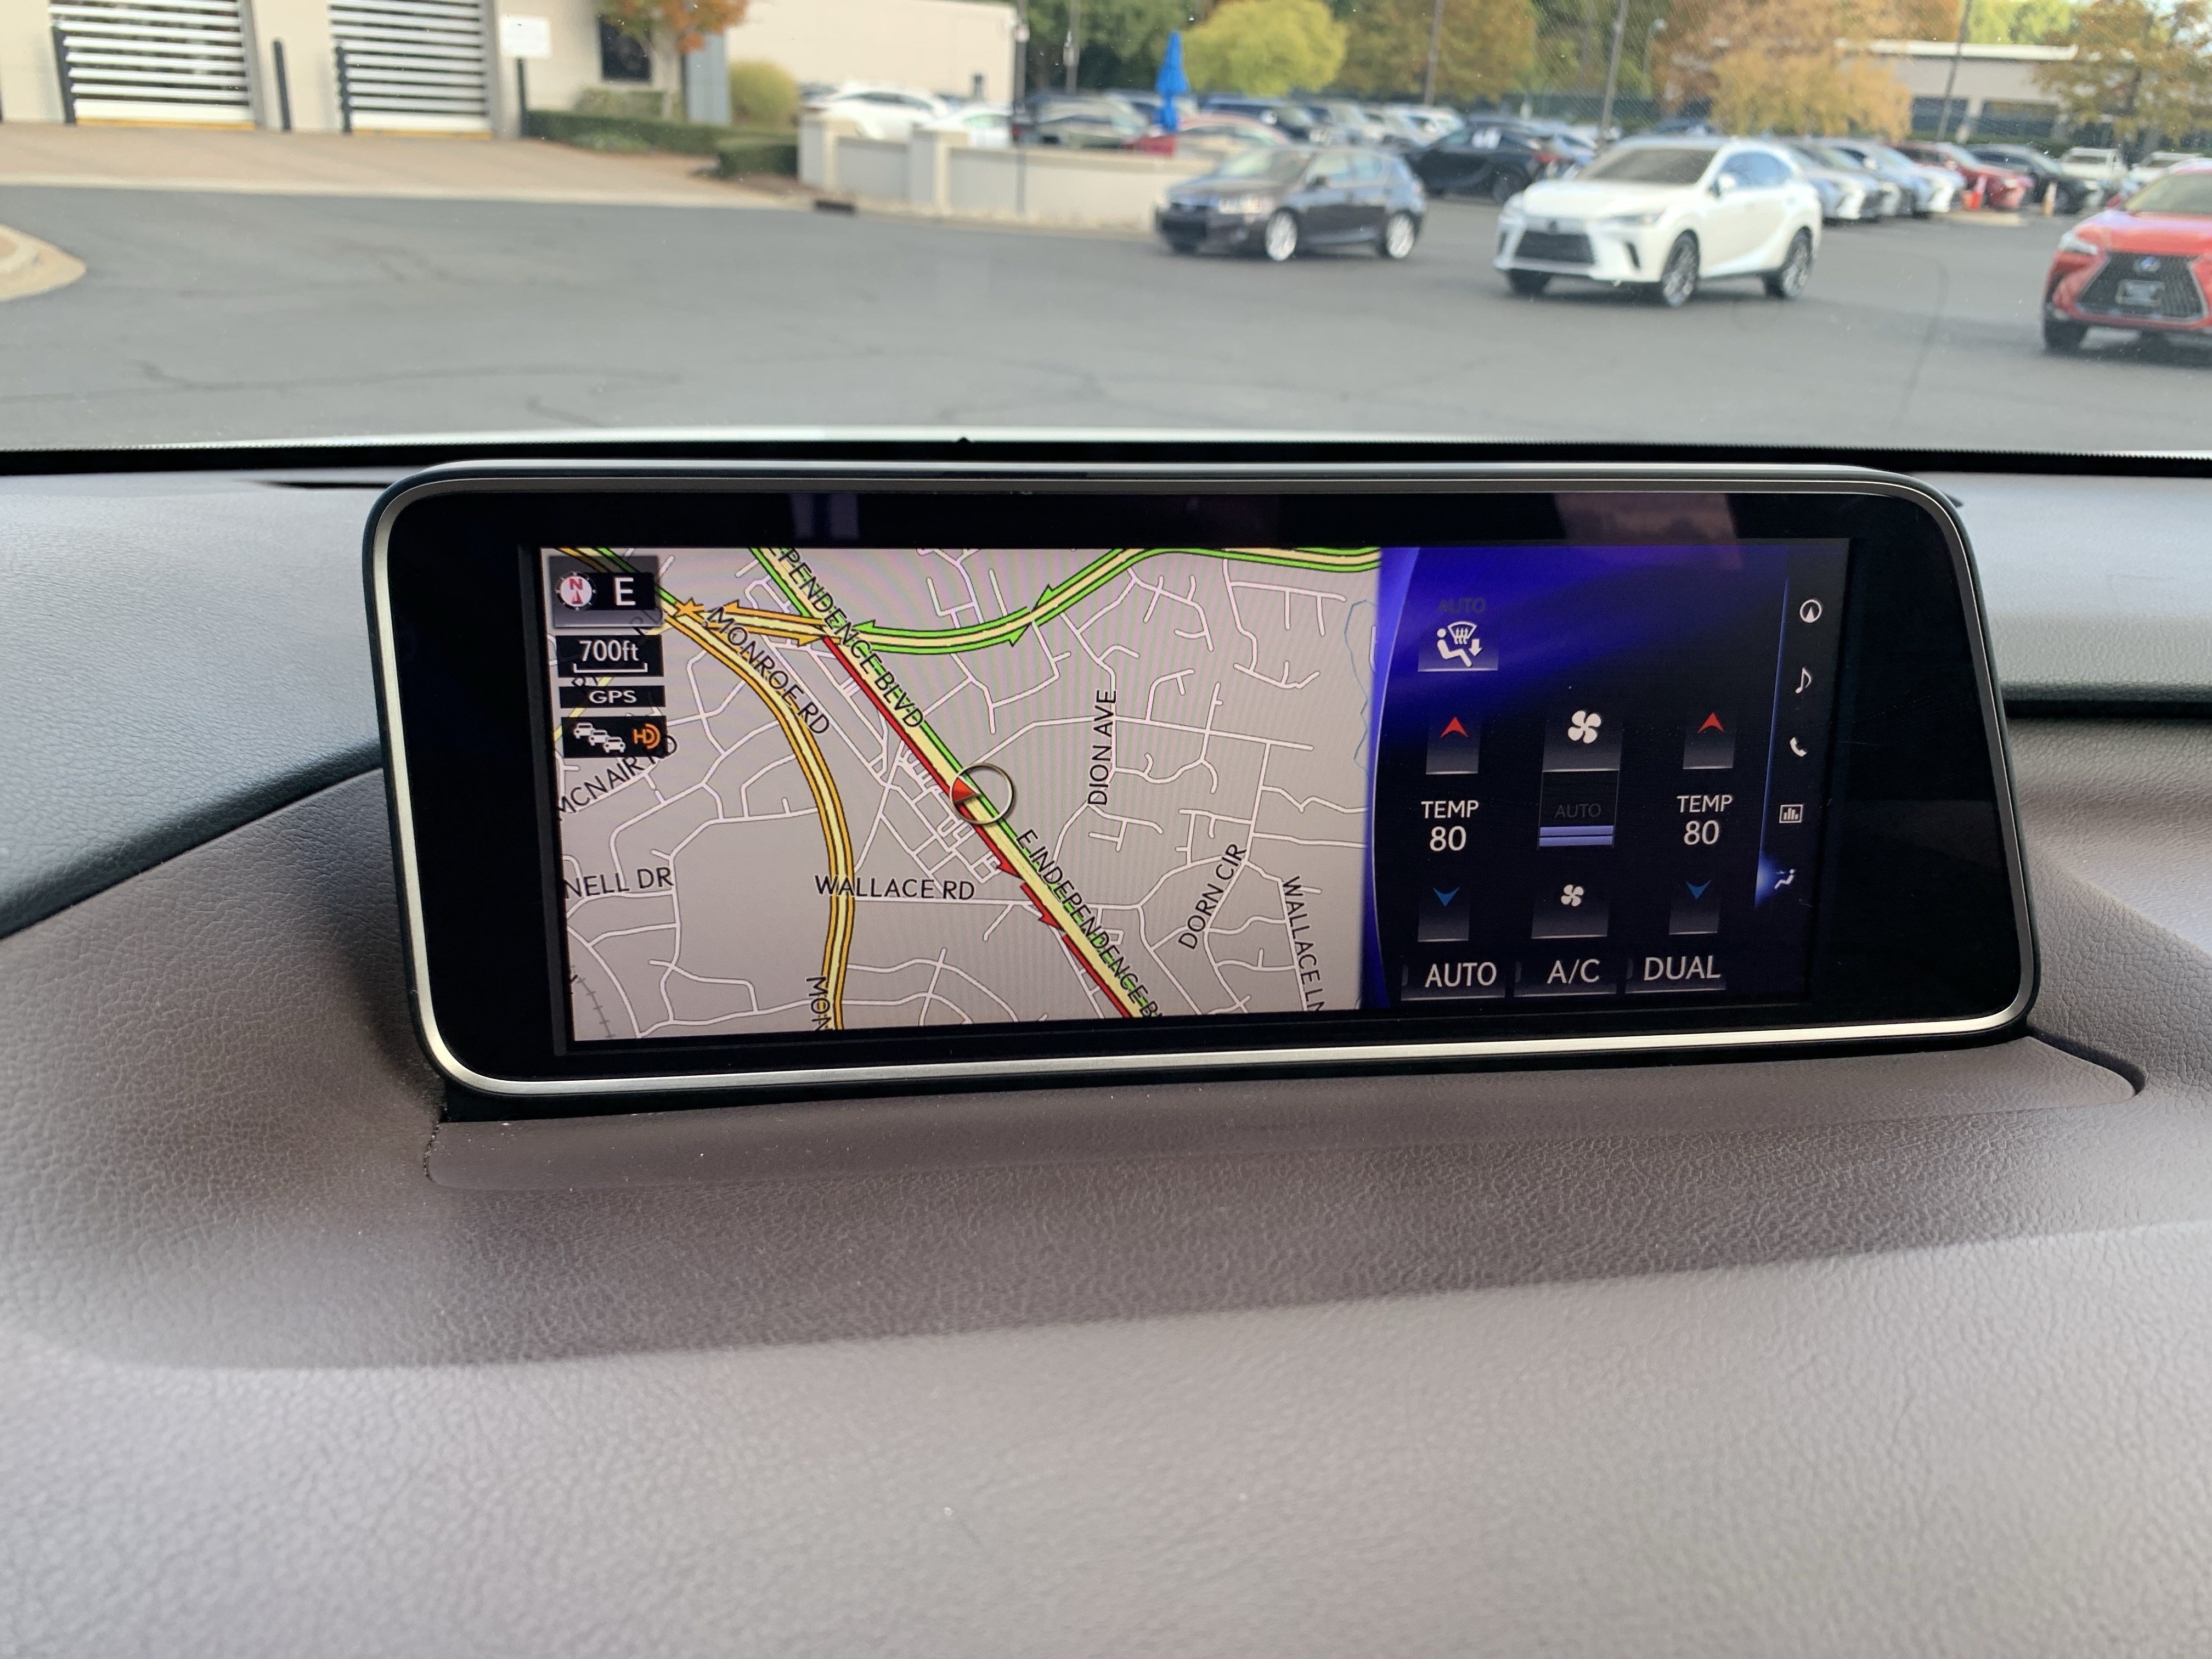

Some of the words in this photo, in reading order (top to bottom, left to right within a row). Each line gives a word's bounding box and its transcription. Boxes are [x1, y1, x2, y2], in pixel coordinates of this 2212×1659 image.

[568, 578, 583, 590] N
[614, 577, 636, 606] E
[1437, 597, 1486, 615] AUTO
[578, 639, 640, 662] 700ft
[706, 606, 805, 705] MONROE
[798, 702, 830, 734] RD
[588, 690, 637, 704] GPS
[874, 671, 924, 727] BLVD
[1093, 690, 1117, 737] AVE
[1087, 745, 1111, 805] DION
[1421, 800, 1480, 819] TEMP
[1554, 804, 1602, 819] AUTO
[1677, 794, 1733, 814] TEMP
[1429, 826, 1467, 852] 80
[1683, 820, 1720, 846] 80
[637, 866, 674, 889] DR
[814, 875, 935, 899] WALLACE
[943, 880, 975, 900] RD
[1178, 883, 1224, 949] DORN
[1215, 843, 1247, 880] CIR
[1016, 829, 1039, 849] E
[1029, 845, 1148, 1003] INDEPENDENCE
[1282, 876, 1321, 985] WALLACE
[1425, 962, 1497, 988] AUTO
[1547, 958, 1600, 985] A/C
[1643, 956, 1721, 981] DUAL
